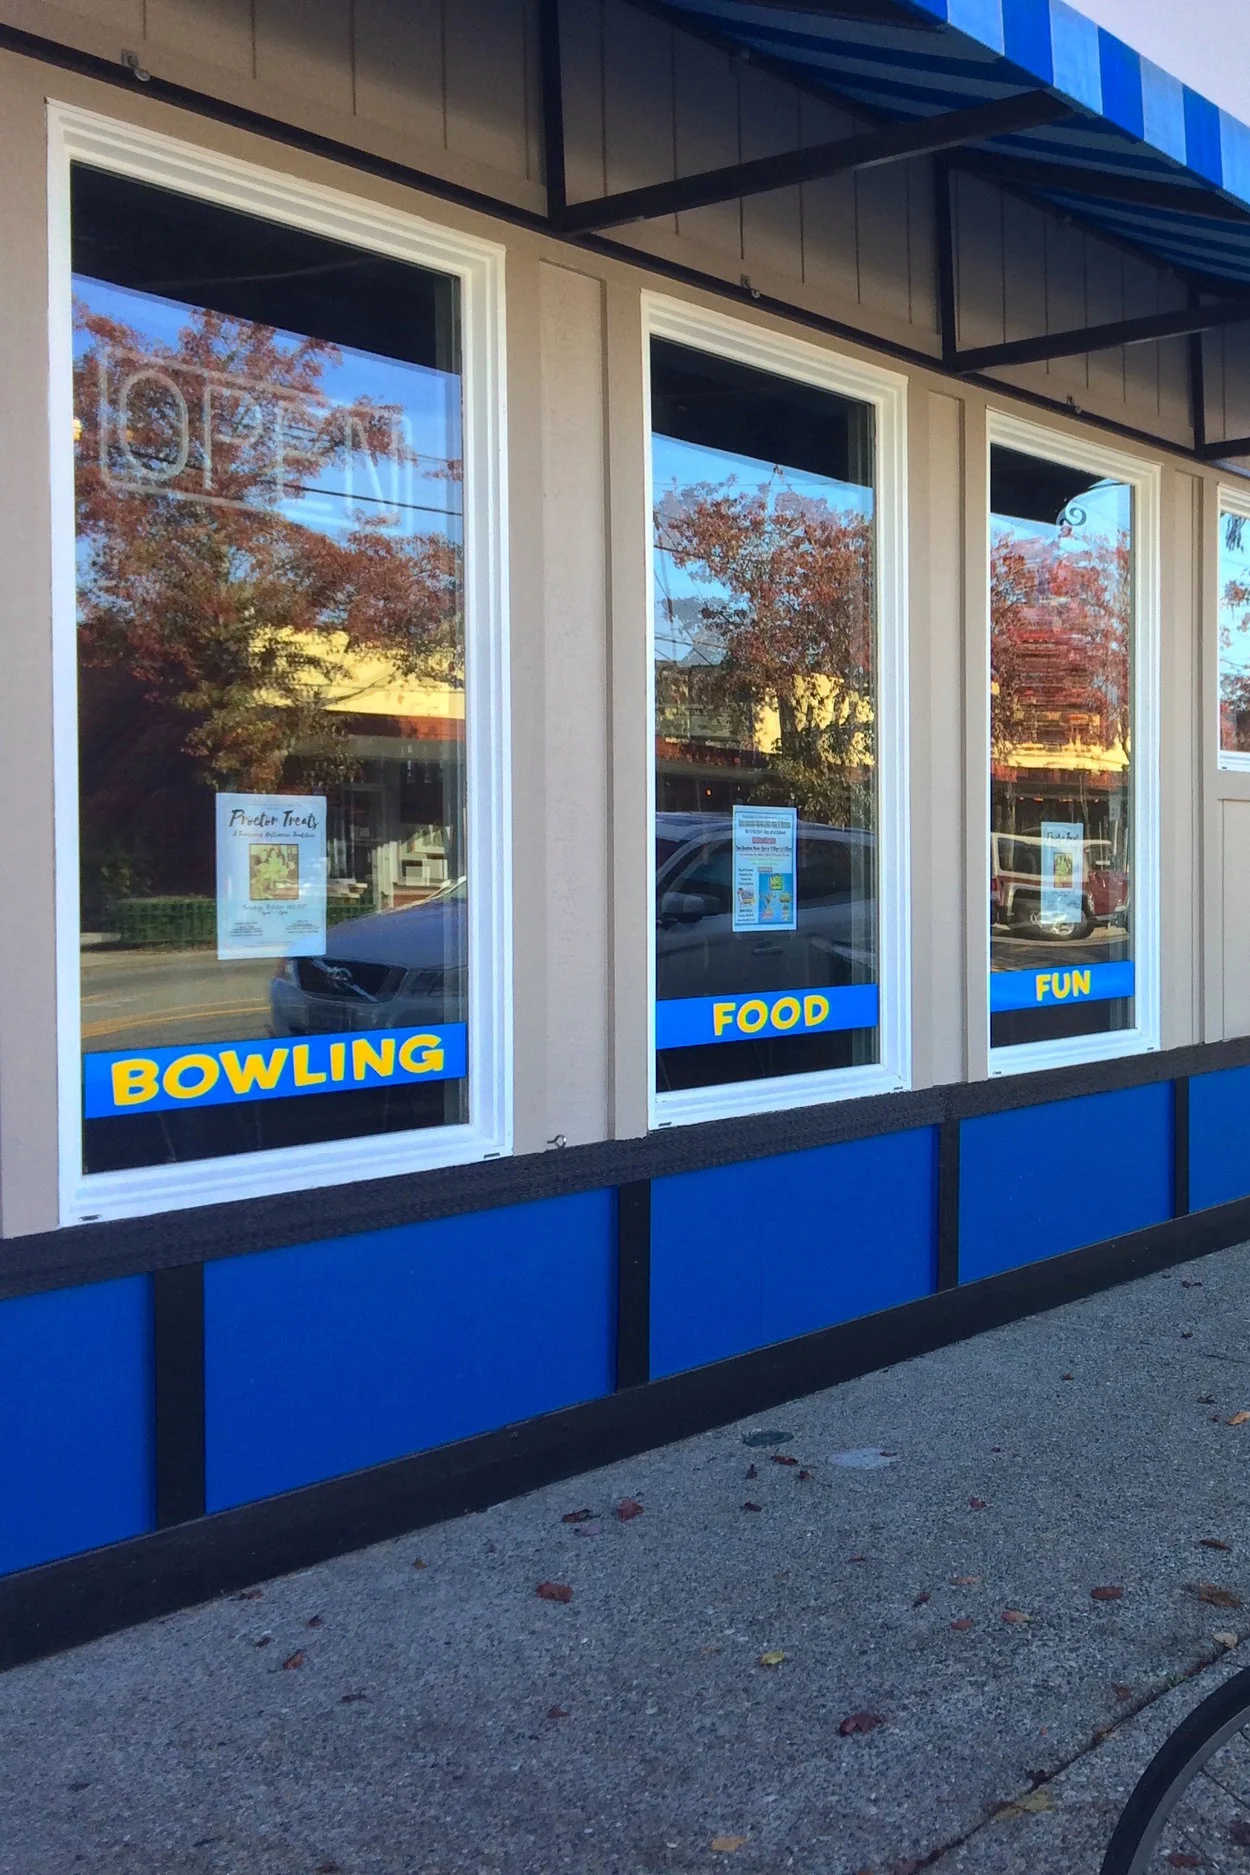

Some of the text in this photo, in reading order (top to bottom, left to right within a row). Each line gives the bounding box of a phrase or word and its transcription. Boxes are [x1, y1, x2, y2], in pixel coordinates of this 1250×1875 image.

[119, 368, 400, 518] OPEN
[229, 809, 319, 830] Proctor Treats
[1035, 969, 1092, 1002] FUN
[713, 994, 830, 1037] FOOD
[111, 1033, 445, 1107] BOWLING
